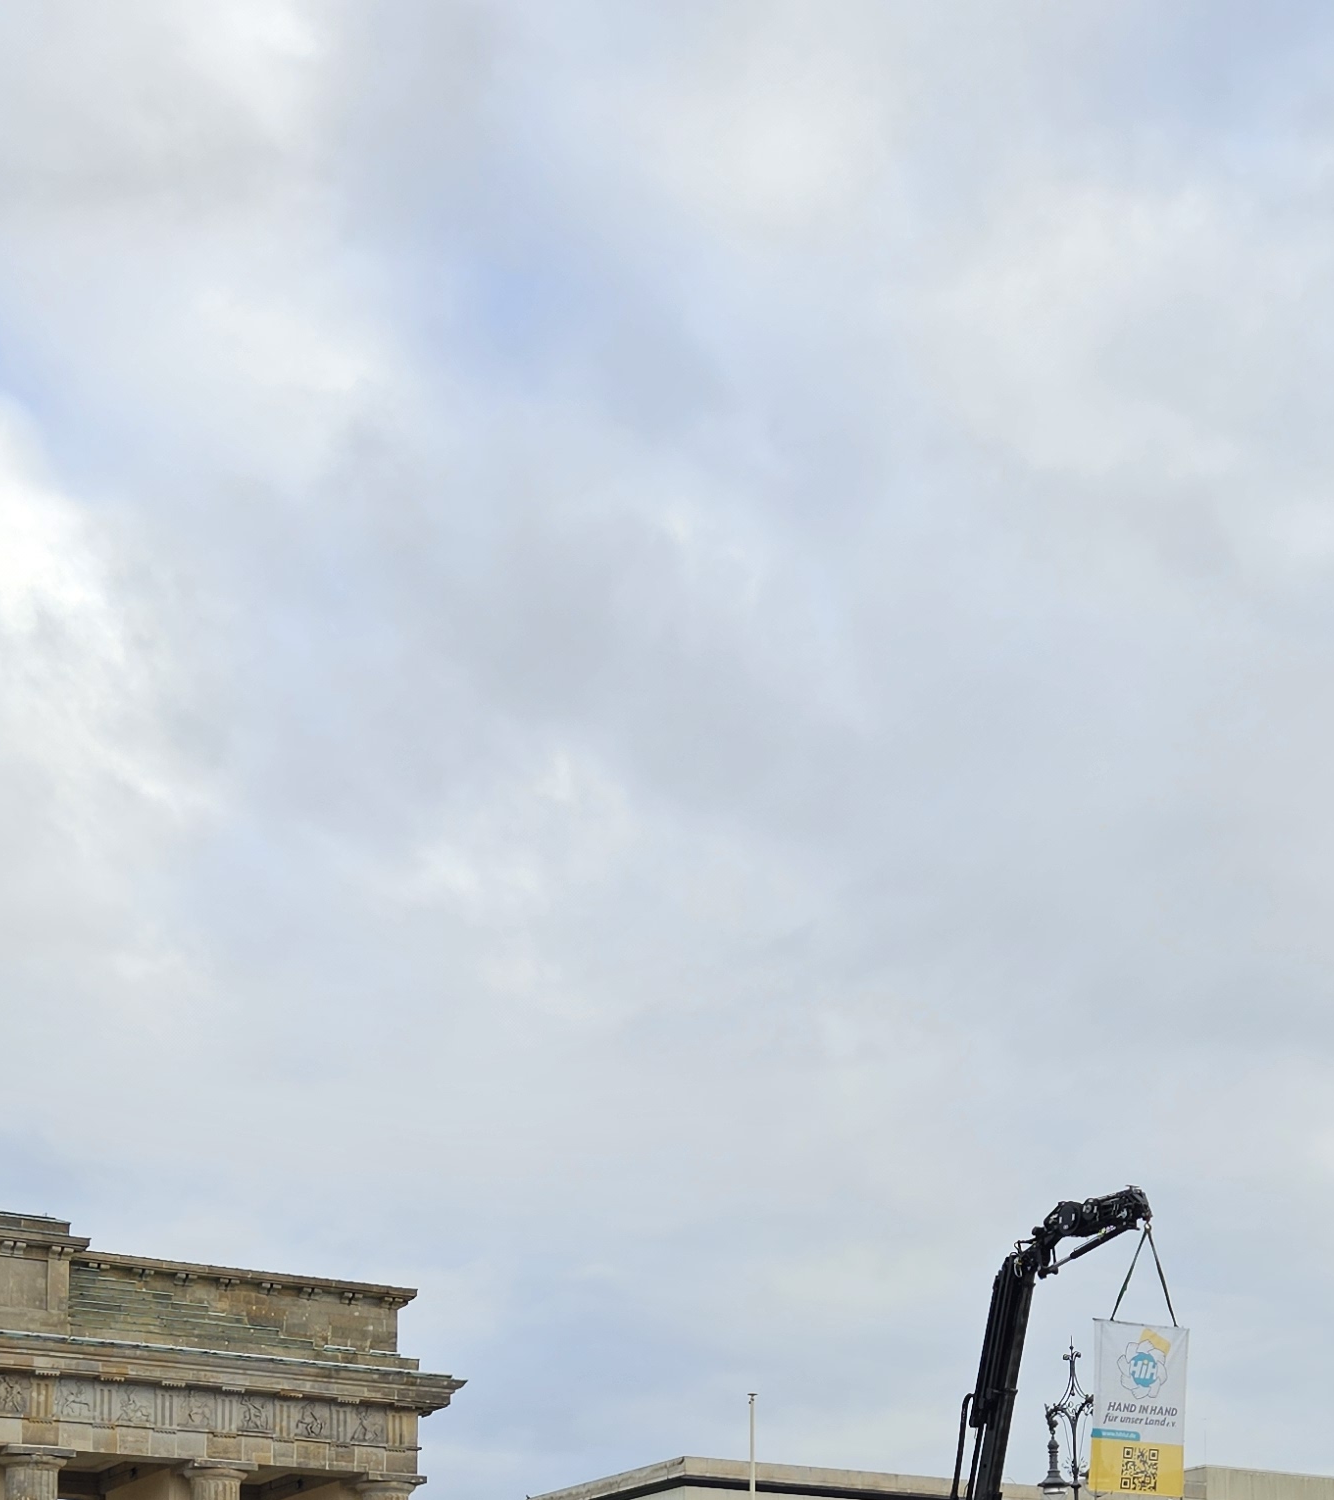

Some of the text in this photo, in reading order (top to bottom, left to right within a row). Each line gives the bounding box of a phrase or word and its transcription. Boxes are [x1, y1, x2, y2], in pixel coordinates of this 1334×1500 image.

[1130, 1360, 1157, 1380] HiH
[1107, 1402, 1177, 1417] HAND IN HAND
[1103, 1412, 1118, 1424] für
[1120, 1416, 1144, 1425] unser
[1145, 1417, 1166, 1427] Land
